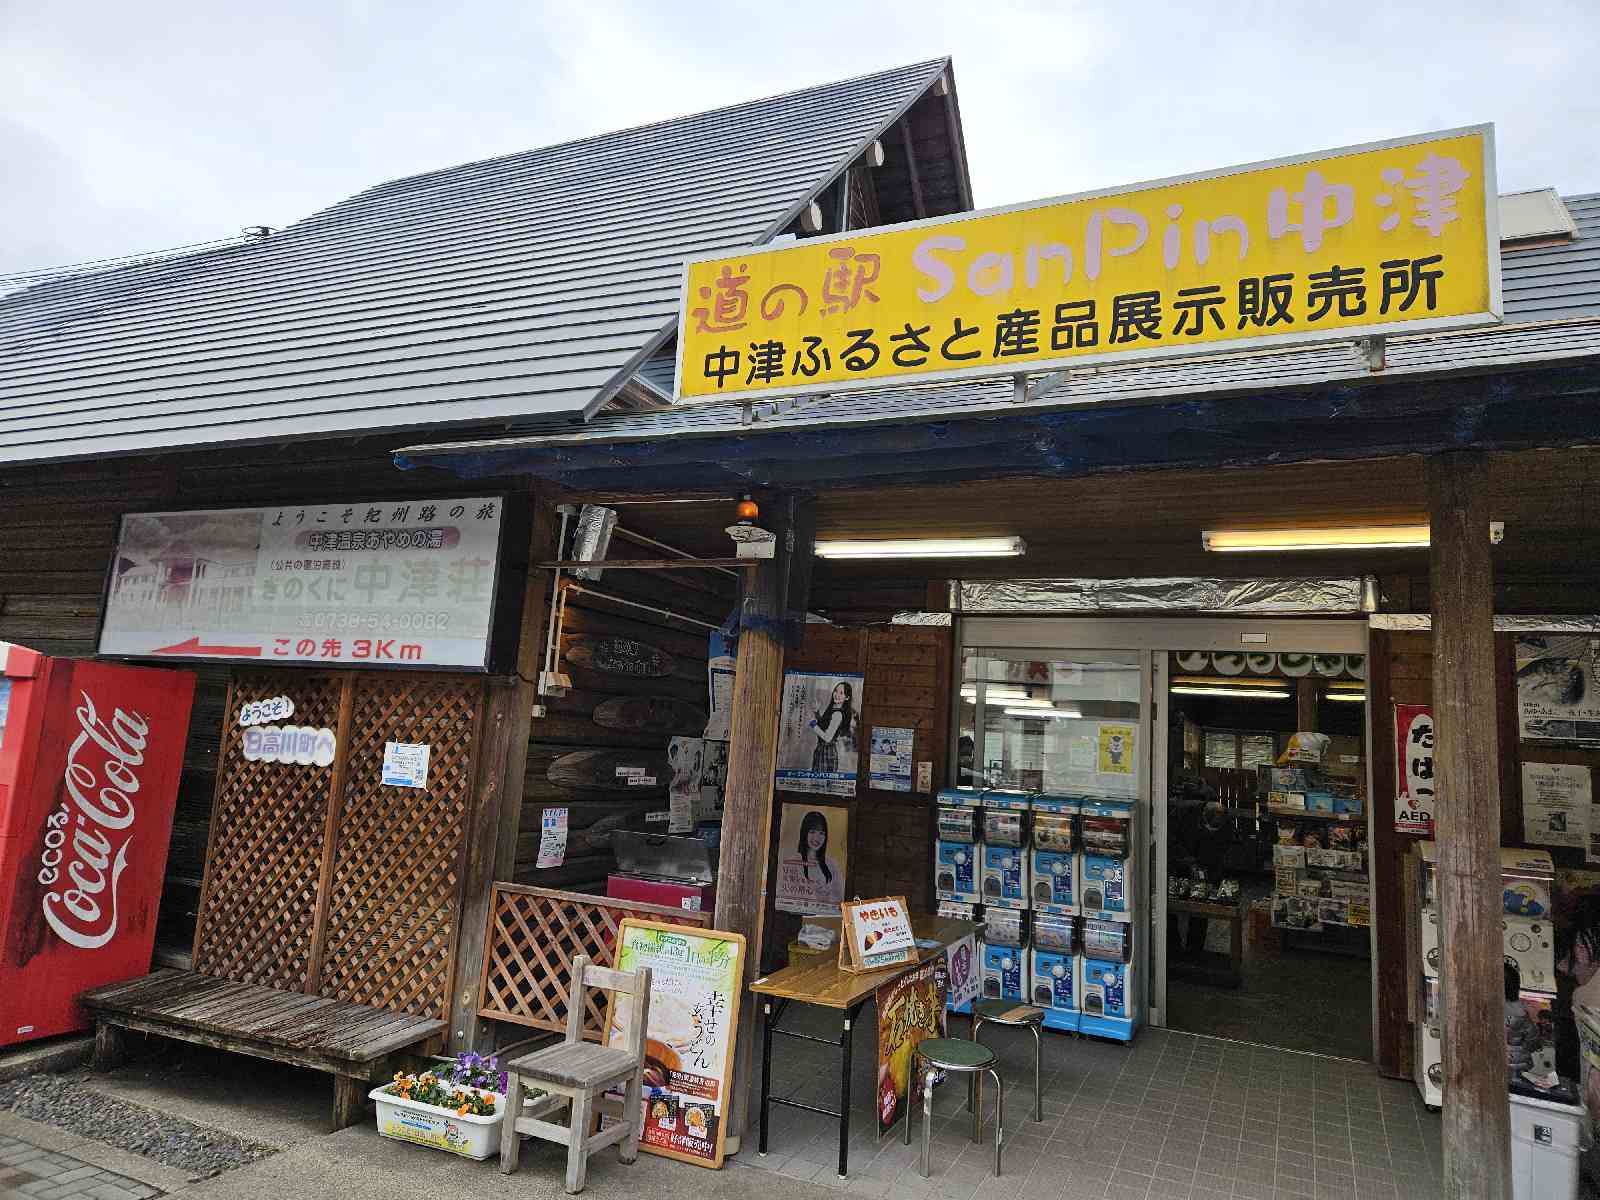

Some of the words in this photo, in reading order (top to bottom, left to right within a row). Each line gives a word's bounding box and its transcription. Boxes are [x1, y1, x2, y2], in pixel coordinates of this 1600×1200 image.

[693, 246, 881, 334] 道の駅
[704, 254, 1444, 388] 中津ふるさと産品展示販売所
[272, 639, 341, 657] この先
[43, 690, 149, 948] Coca-Cola
[1399, 811, 1430, 822] AED
